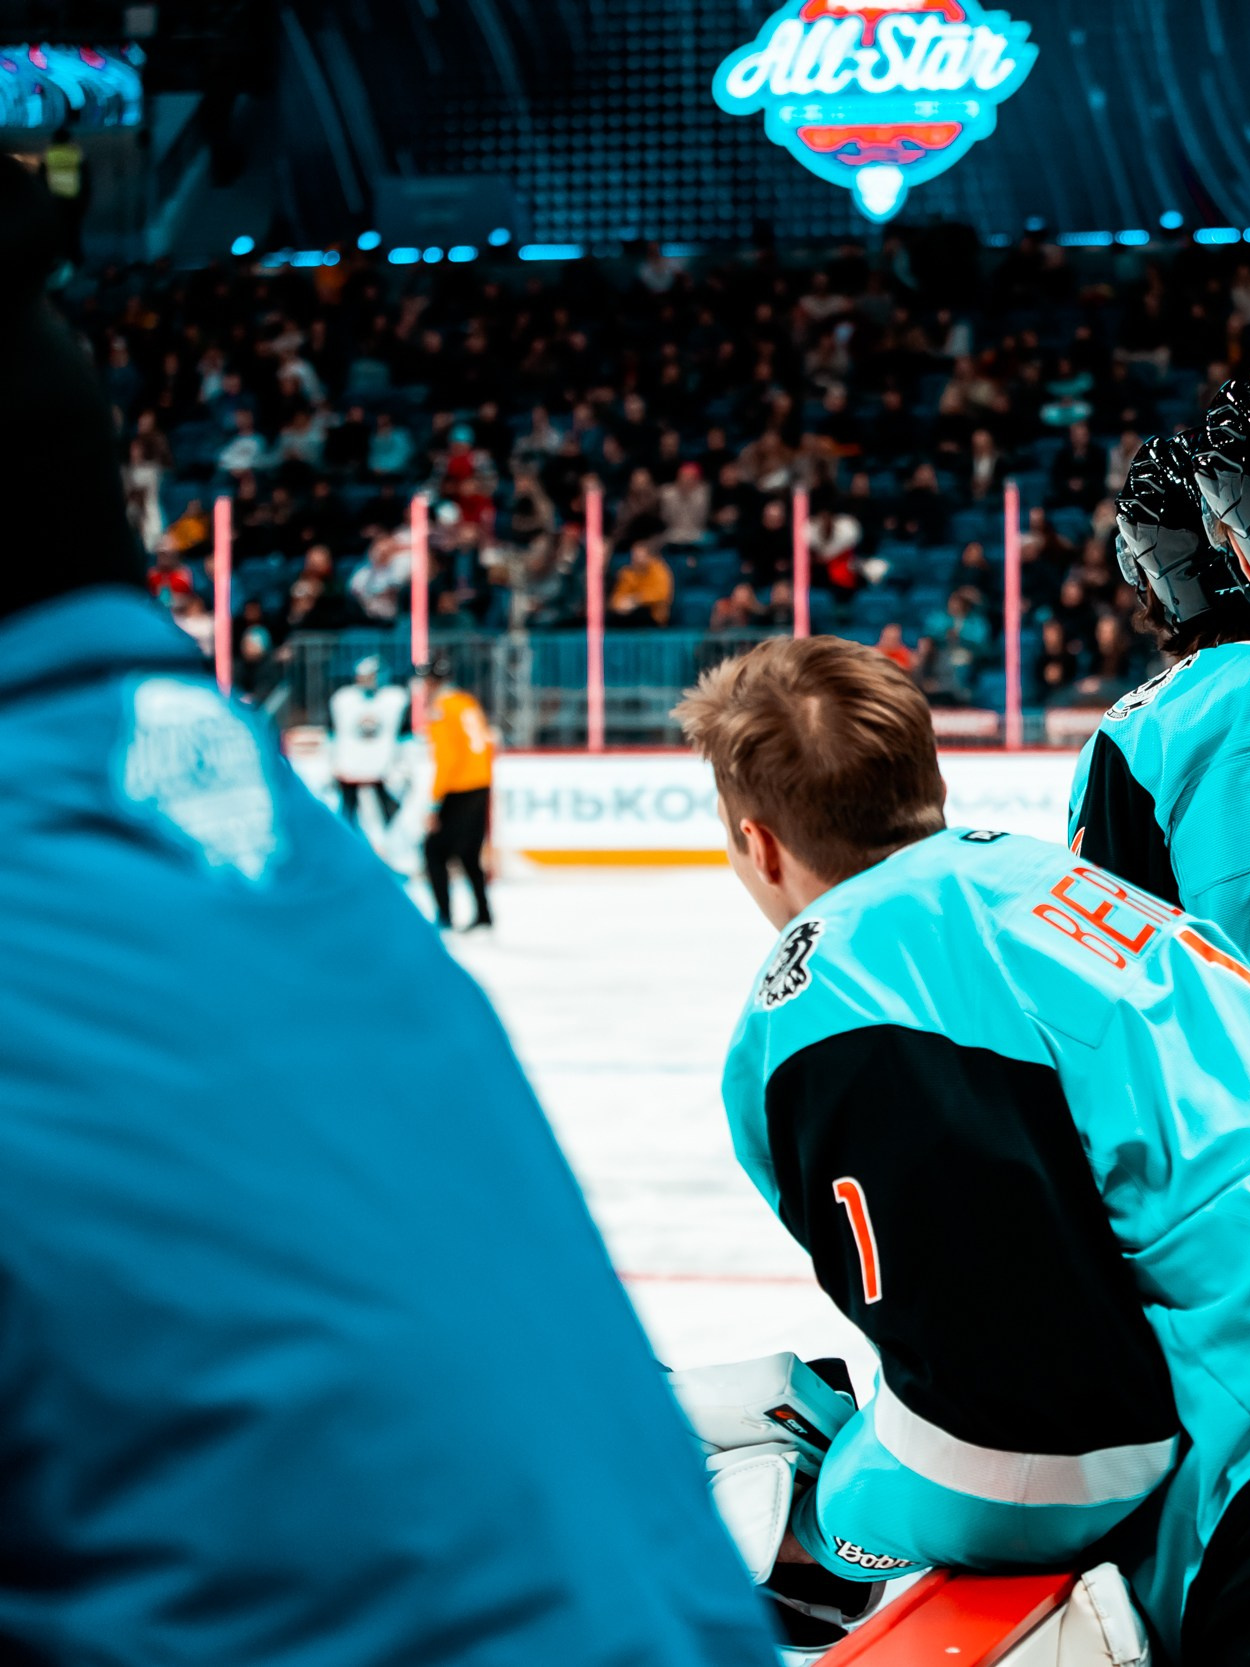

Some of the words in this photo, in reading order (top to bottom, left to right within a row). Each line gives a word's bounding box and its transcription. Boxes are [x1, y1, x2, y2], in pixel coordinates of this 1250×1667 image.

[726, 14, 1016, 98] All-Star
[1031, 865, 1183, 971] BER
[832, 1176, 882, 1305] 1
